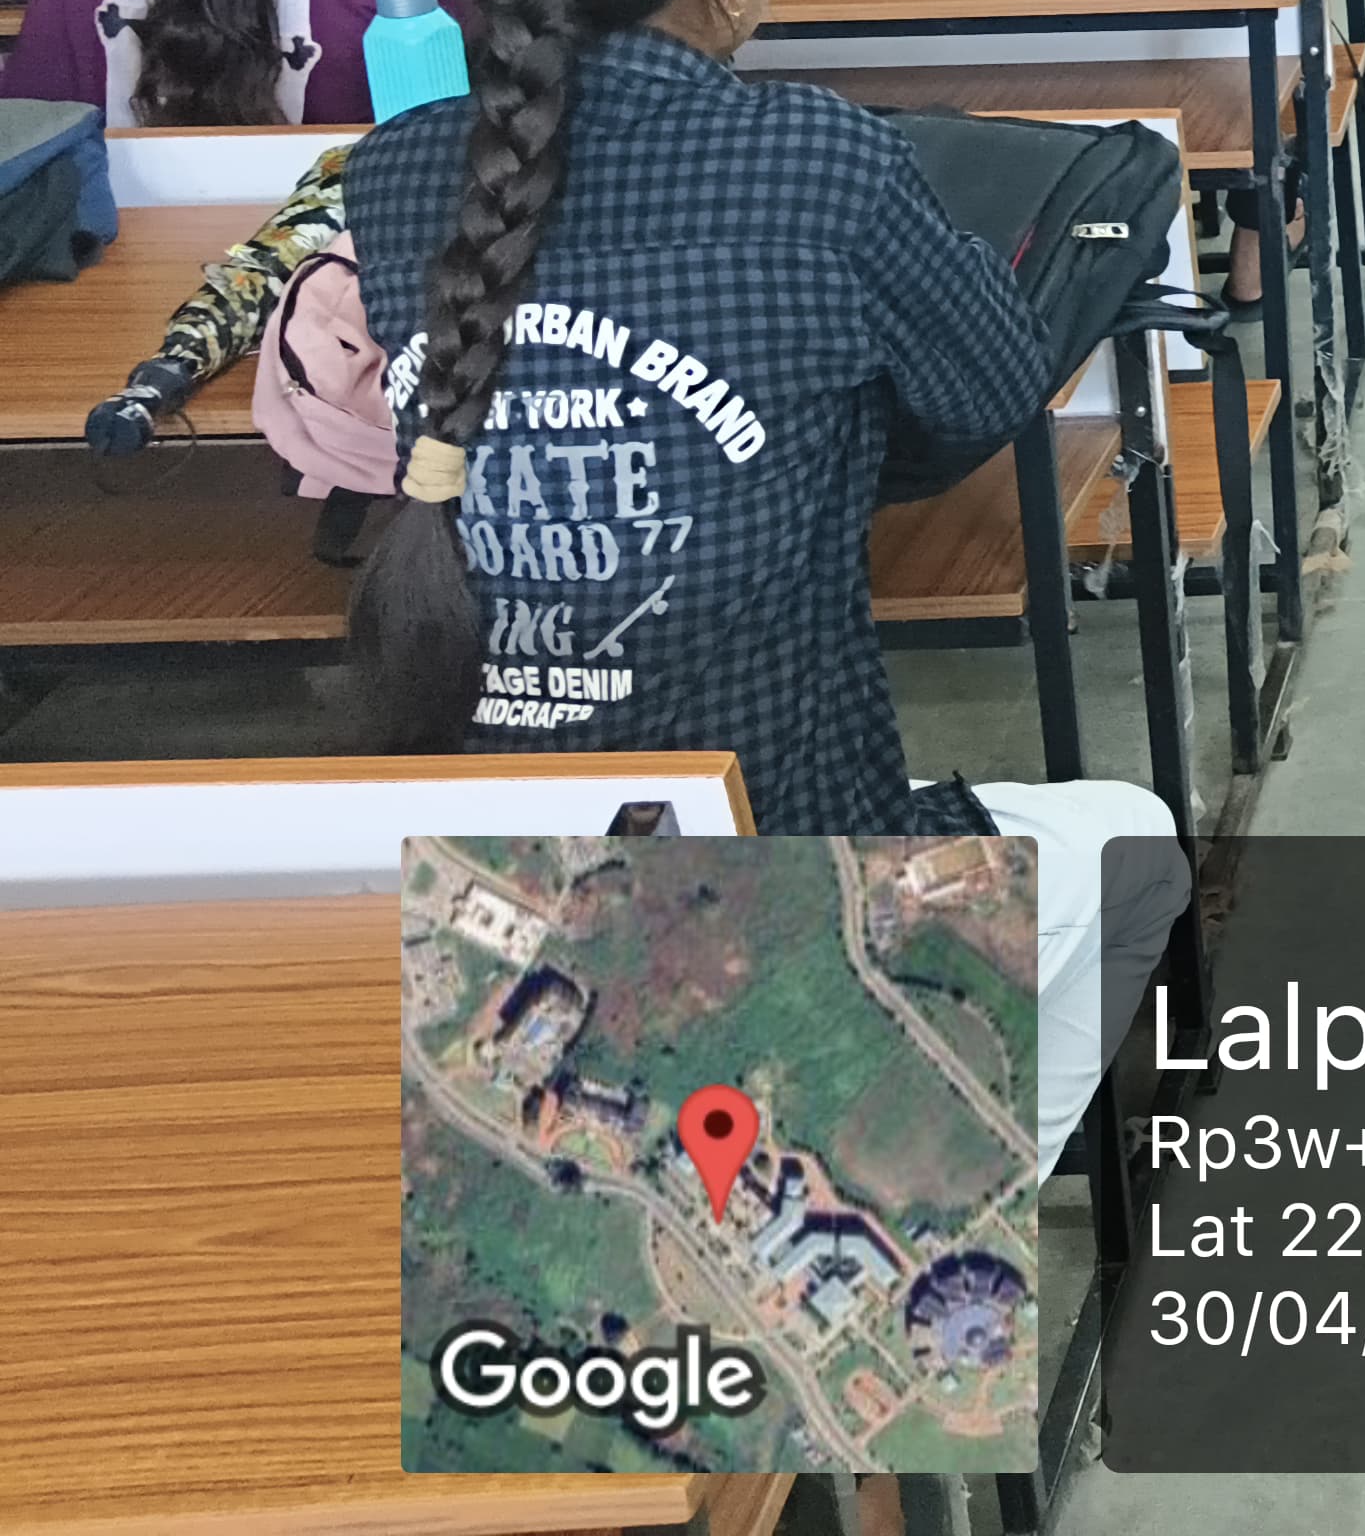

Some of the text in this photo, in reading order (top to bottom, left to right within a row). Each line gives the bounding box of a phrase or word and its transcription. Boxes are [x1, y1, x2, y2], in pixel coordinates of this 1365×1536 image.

[504, 303, 631, 368] RBAN
[630, 338, 767, 464] BRAND
[521, 388, 624, 430] YORK
[632, 515, 694, 556] 77
[547, 666, 633, 702] DENIM
